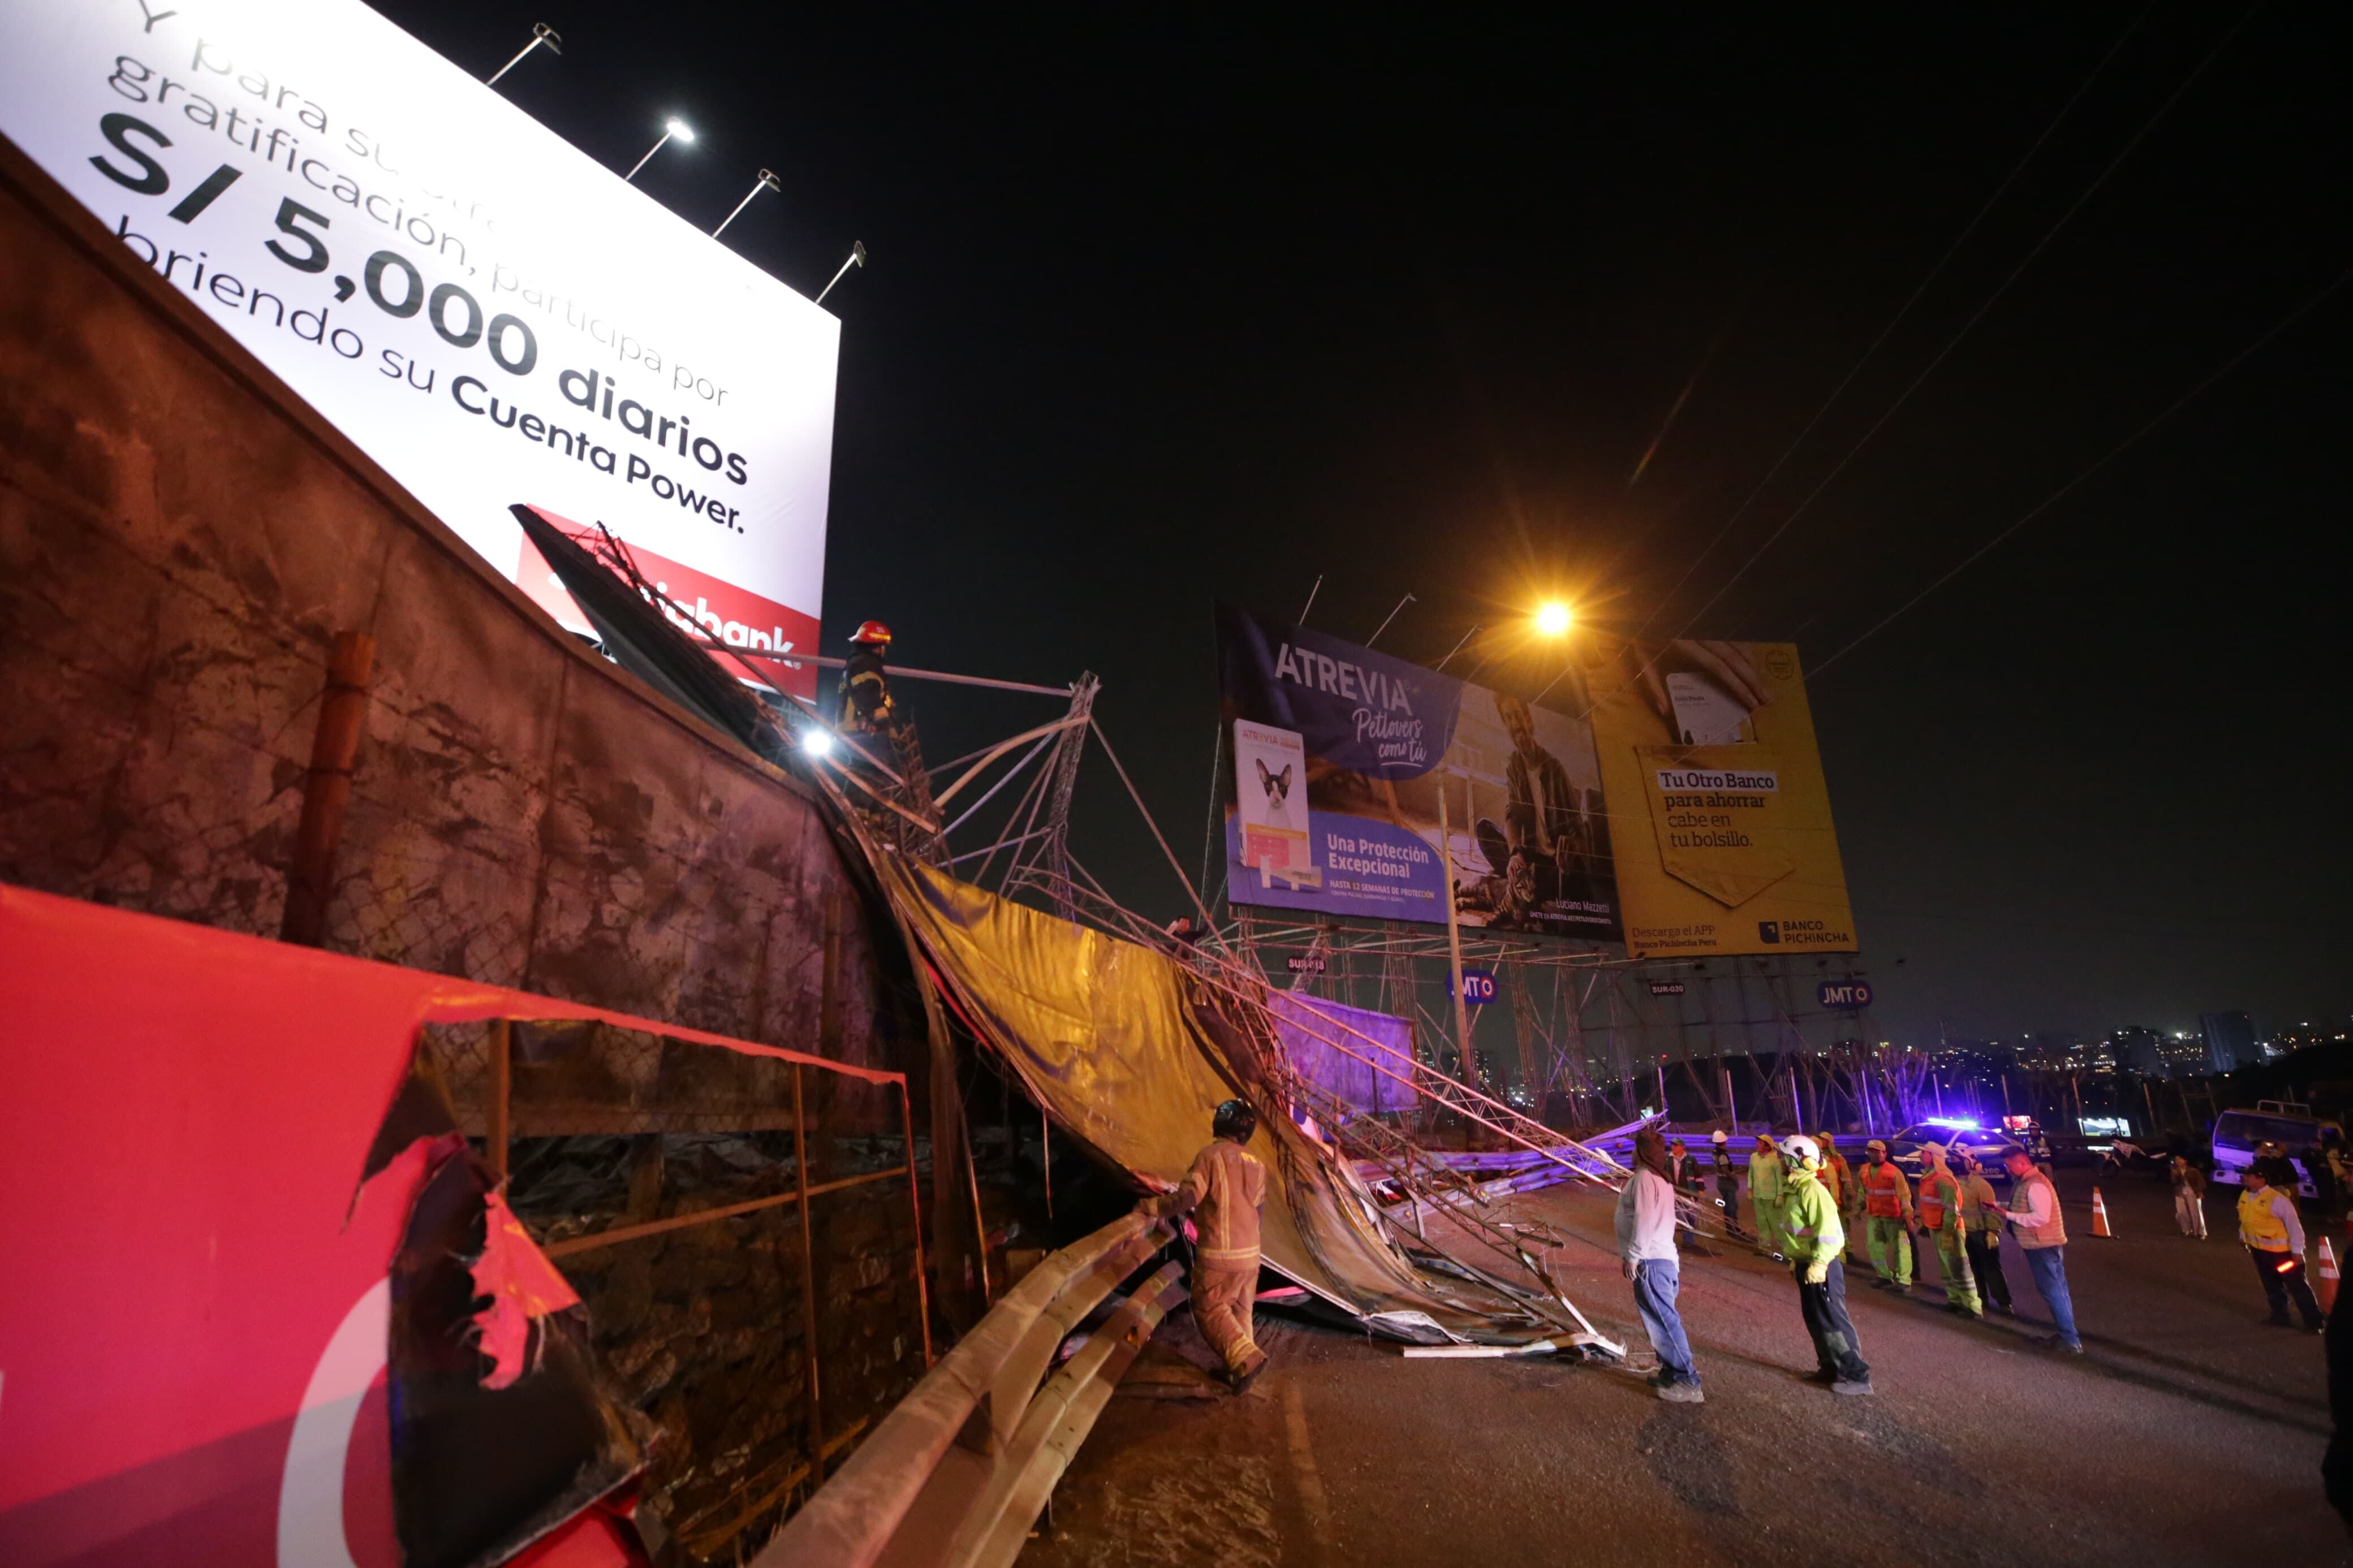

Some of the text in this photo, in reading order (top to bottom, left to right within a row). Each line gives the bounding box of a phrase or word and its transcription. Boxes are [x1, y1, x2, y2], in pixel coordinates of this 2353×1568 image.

[191, 37, 327, 134] para
[107, 55, 477, 276] gratificación,
[492, 262, 661, 373] participa
[673, 362, 729, 406] por
[88, 112, 243, 224] S/
[264, 196, 538, 376] 5,000
[559, 368, 747, 485] diarios
[379, 348, 435, 393] su
[451, 375, 616, 474] Cuenta
[627, 453, 744, 534] Power.
[1275, 642, 1412, 716] ATREVIA
[1352, 707, 1423, 743] Petlovers
[1378, 742, 1406, 758] como
[1661, 772, 1774, 789] Tu Otro Banco
[1664, 792, 1765, 811] para ahorrar
[1667, 811, 1731, 828] cabe en
[1670, 831, 1753, 847] tu bolsillo.
[1327, 833, 1355, 853] Una
[1359, 838, 1429, 864] Protección
[1329, 852, 1411, 878] Excepcional
[1330, 879, 1351, 889] HASTA
[1352, 882, 1360, 891] 12
[1361, 883, 1390, 894] SEMANAS
[1391, 887, 1399, 895] DE
[1556, 897, 1581, 910] Luciano
[1632, 925, 1716, 939] Descarga el APP
[1783, 921, 1824, 931] BANCO
[1659, 939, 1697, 948] Pichincha
[1785, 932, 1850, 943] PICHINCHA
[1450, 976, 1493, 997] MTO
[1652, 985, 1684, 994] SUR-020
